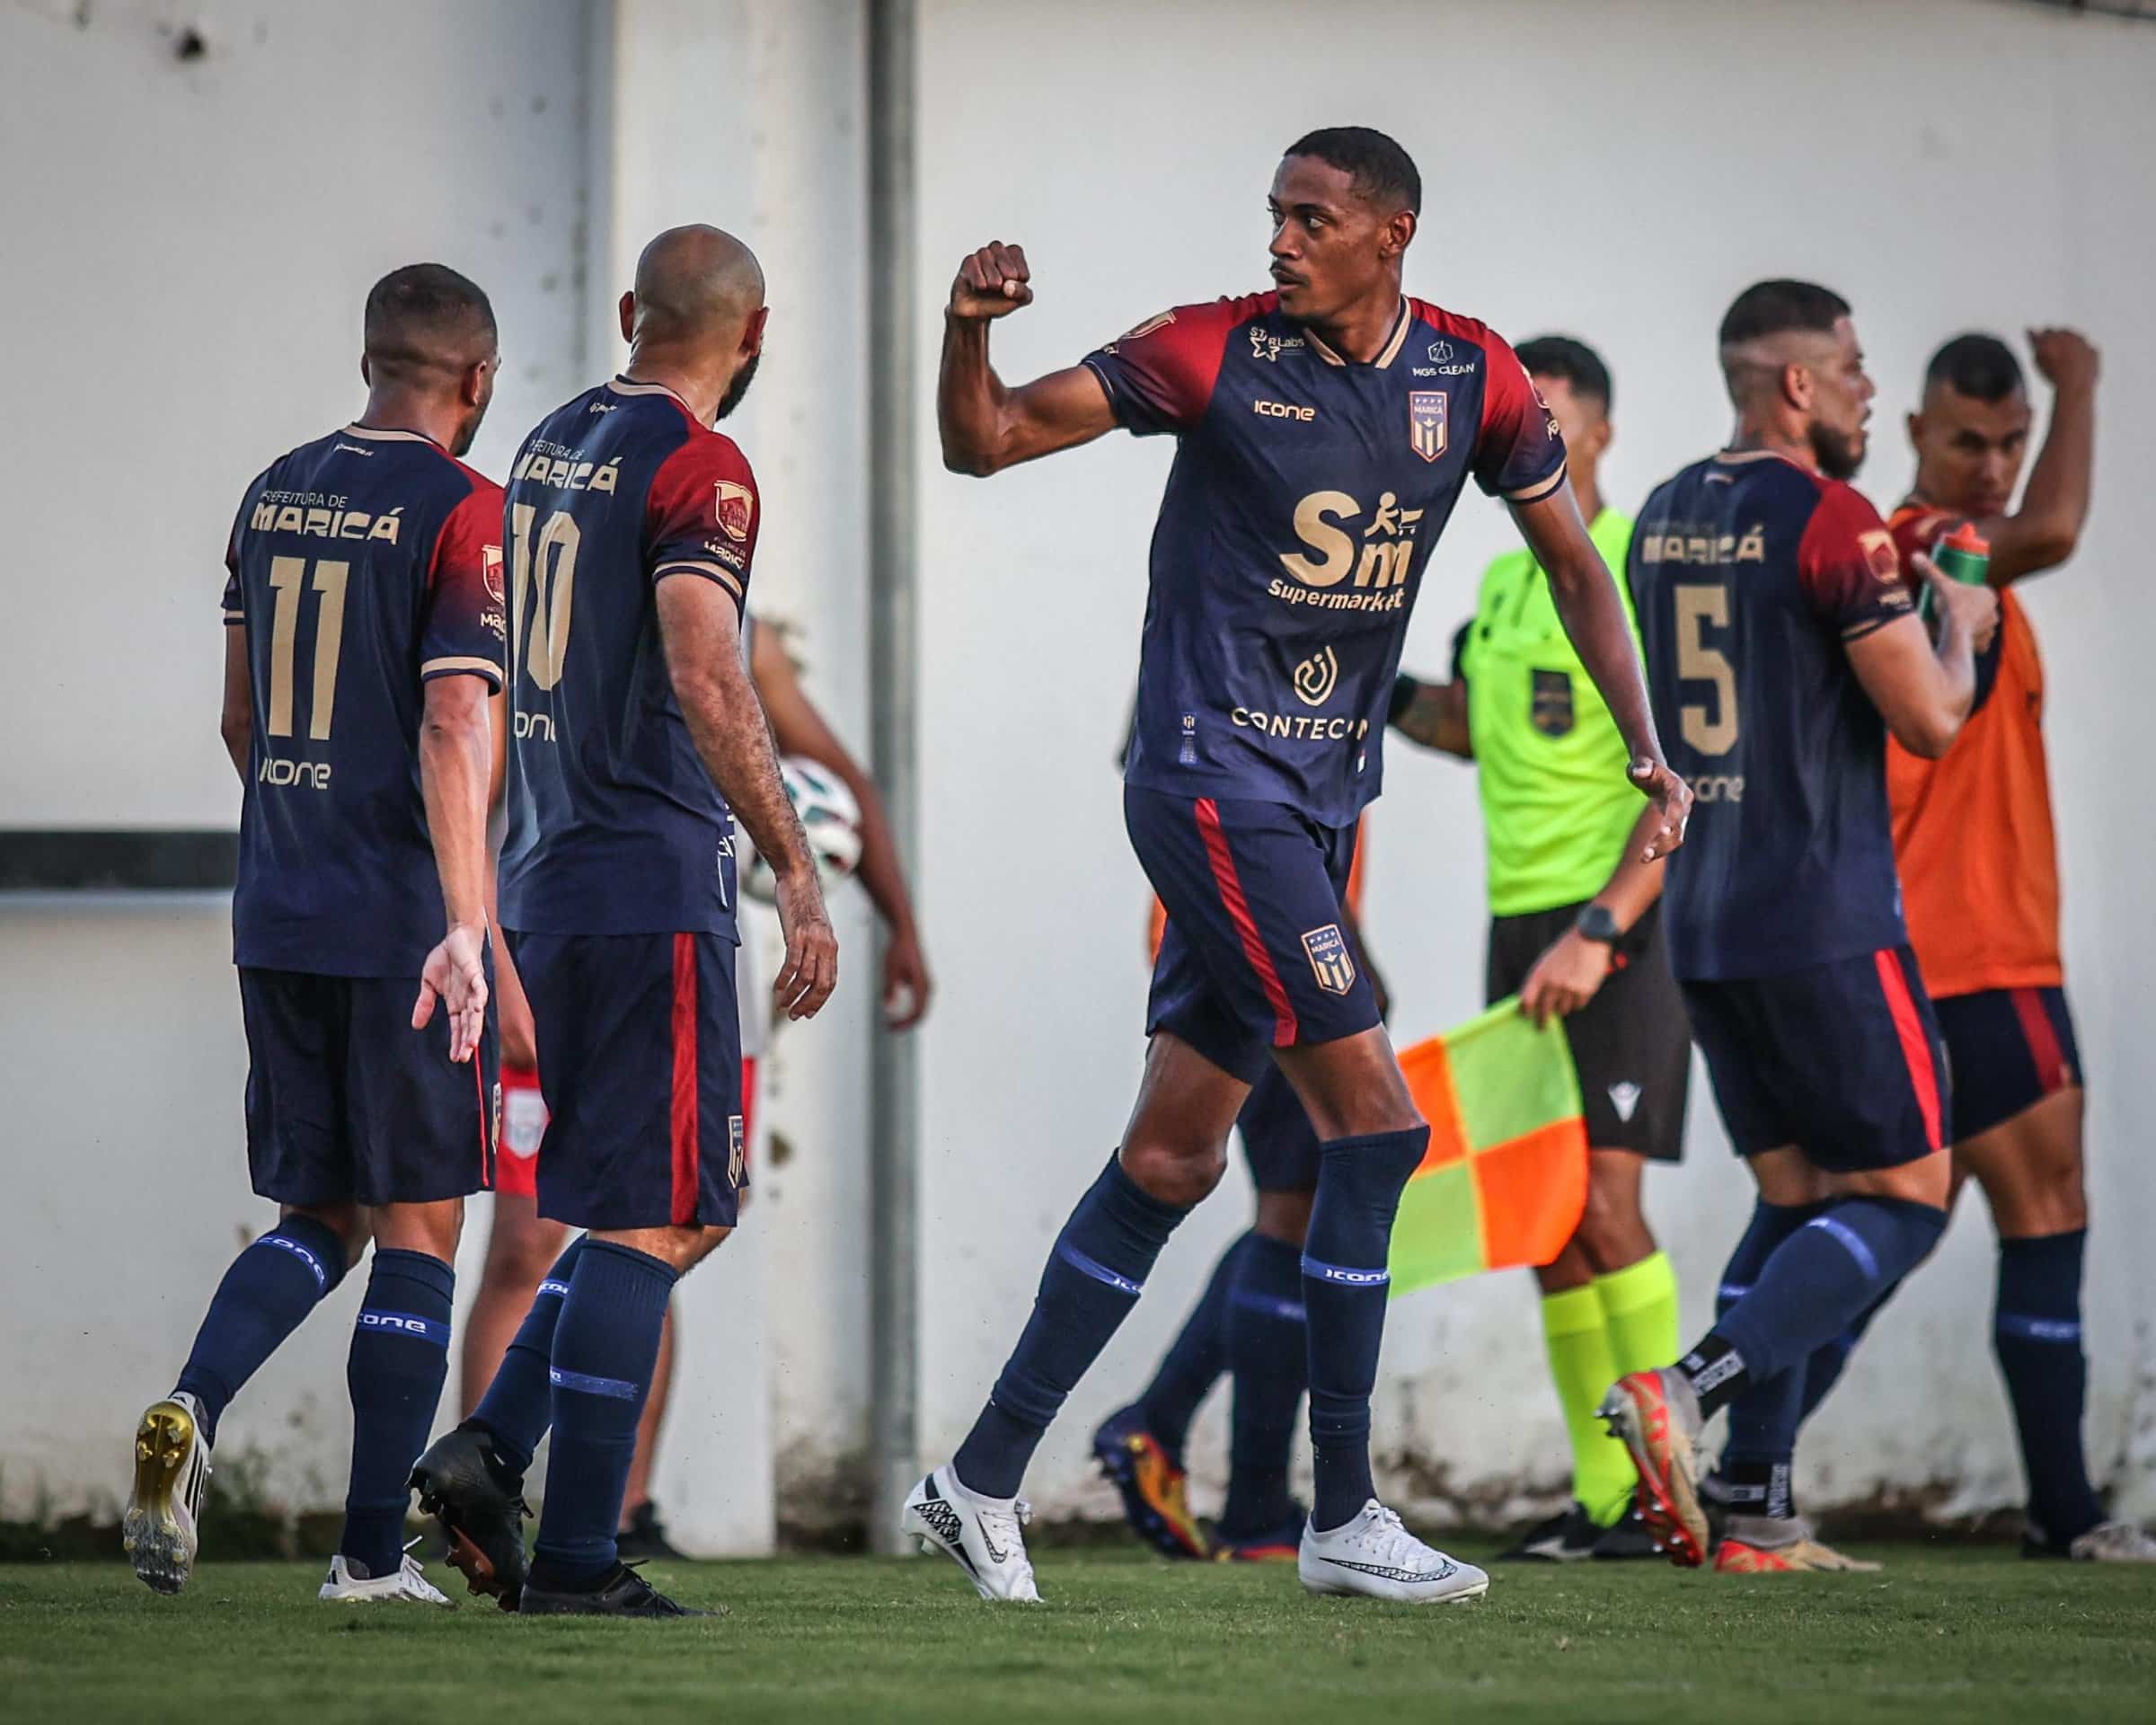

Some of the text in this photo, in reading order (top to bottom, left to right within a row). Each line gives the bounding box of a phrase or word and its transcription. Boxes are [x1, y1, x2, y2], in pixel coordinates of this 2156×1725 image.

[1438, 362, 1475, 376] CLEAN
[251, 503, 405, 545] MARICÁ
[328, 494, 349, 509] DE
[269, 555, 350, 741] 11
[513, 503, 581, 691] 10
[1674, 586, 1738, 756] 5
